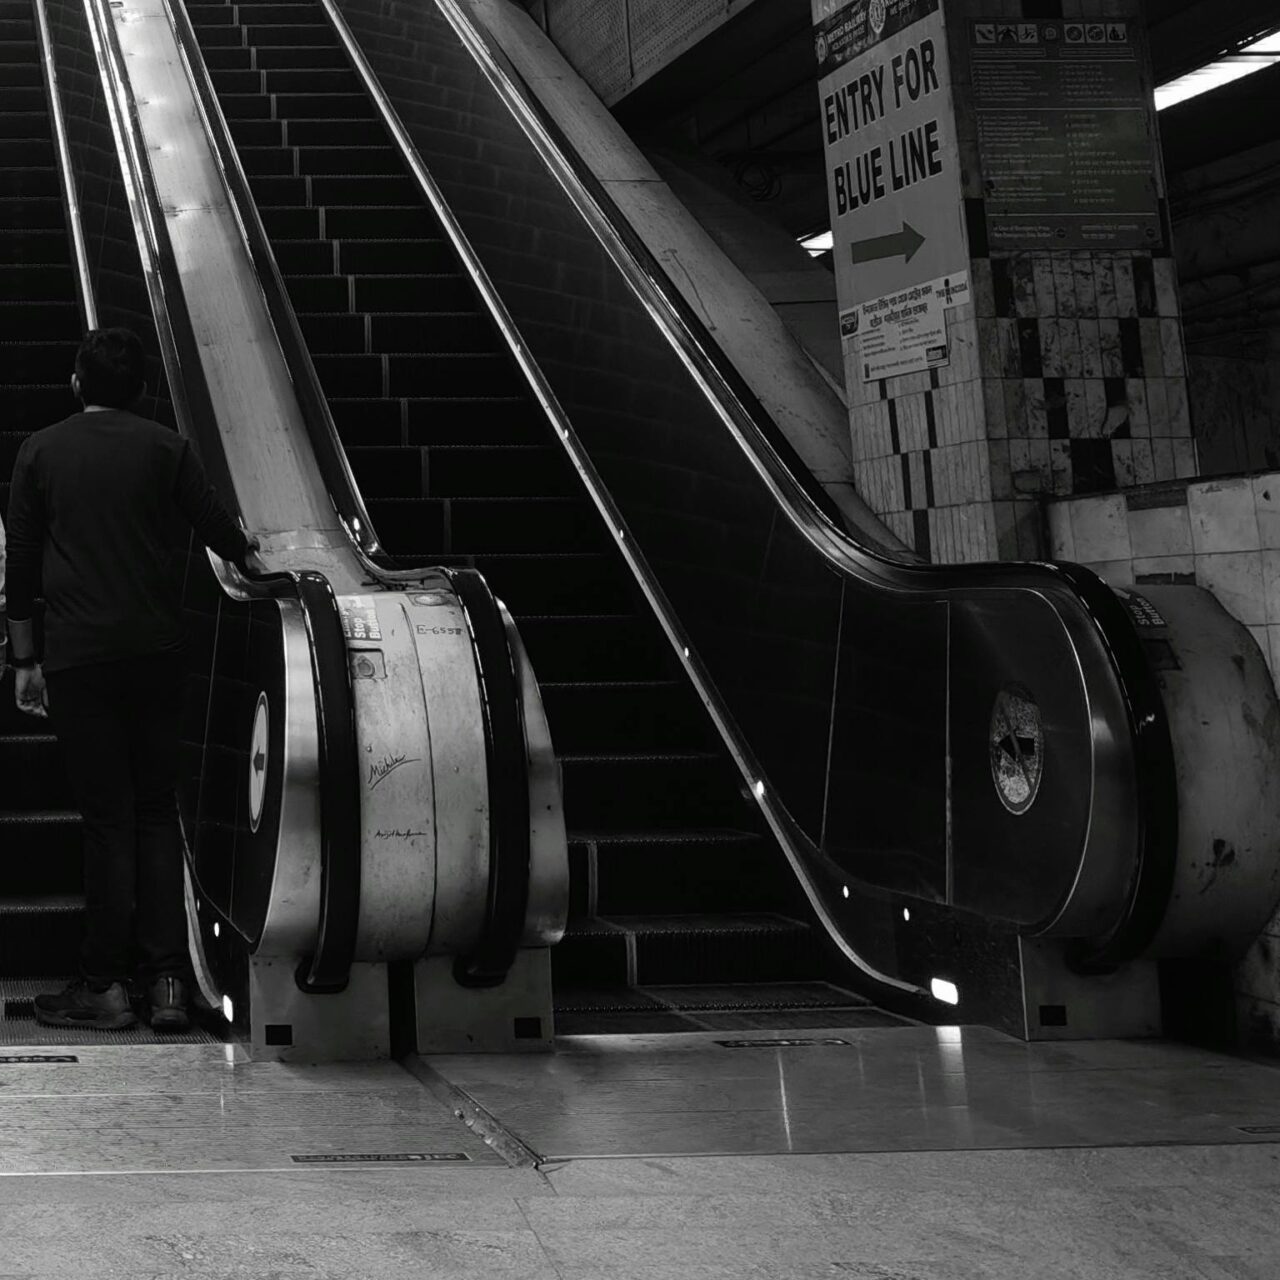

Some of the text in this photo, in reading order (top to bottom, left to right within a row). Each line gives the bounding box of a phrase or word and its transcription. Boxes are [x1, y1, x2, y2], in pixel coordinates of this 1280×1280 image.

[825, 65, 885, 145] ENTRY
[891, 39, 939, 109] FOR
[834, 147, 885, 216] BLUE
[889, 119, 942, 191] LINE
[353, 617, 366, 639] Stop
[366, 608, 382, 639] Button
[1128, 605, 1151, 626] Stop
